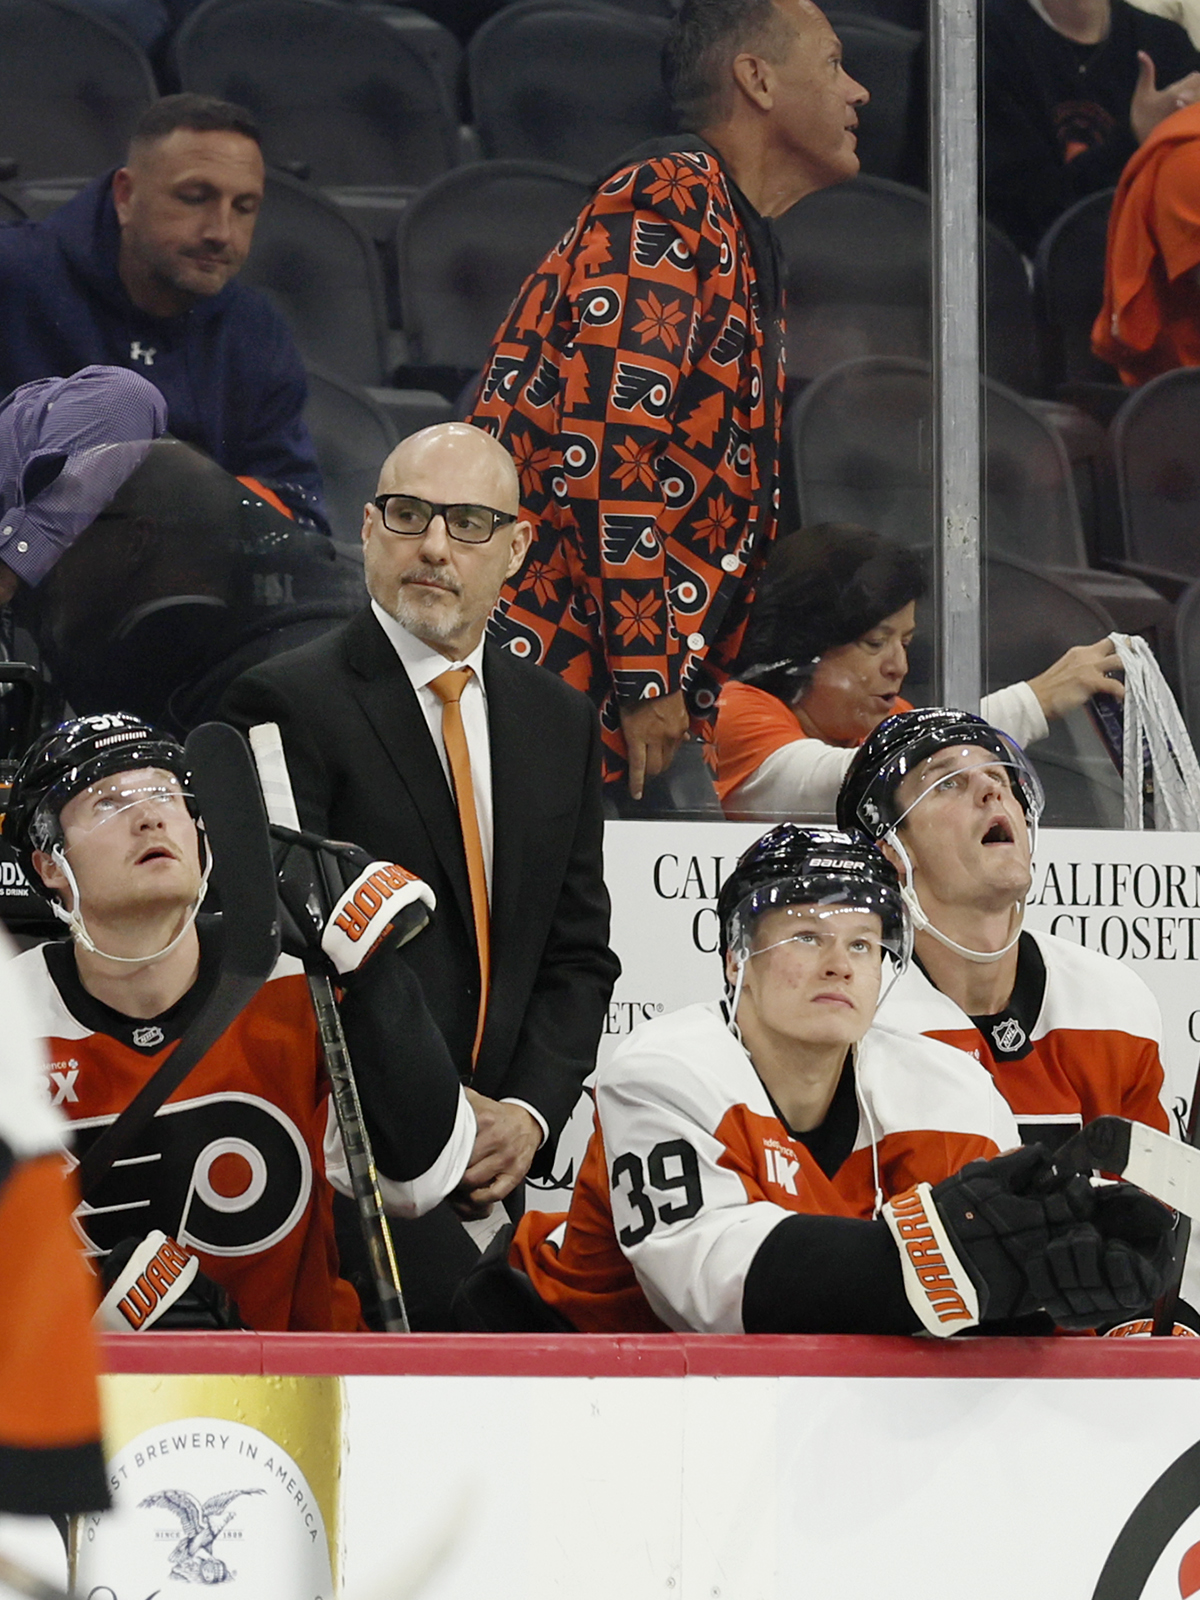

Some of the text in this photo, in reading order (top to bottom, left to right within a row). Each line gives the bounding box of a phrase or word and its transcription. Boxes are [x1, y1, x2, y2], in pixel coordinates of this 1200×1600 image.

[6, 888, 29, 897] DRINK
[808, 858, 866, 871] BAUER
[612, 1138, 704, 1248] 39
[134, 1432, 230, 1468] BREWERY
[238, 1440, 258, 1459] IN
[264, 1457, 318, 1543] AMERICA
